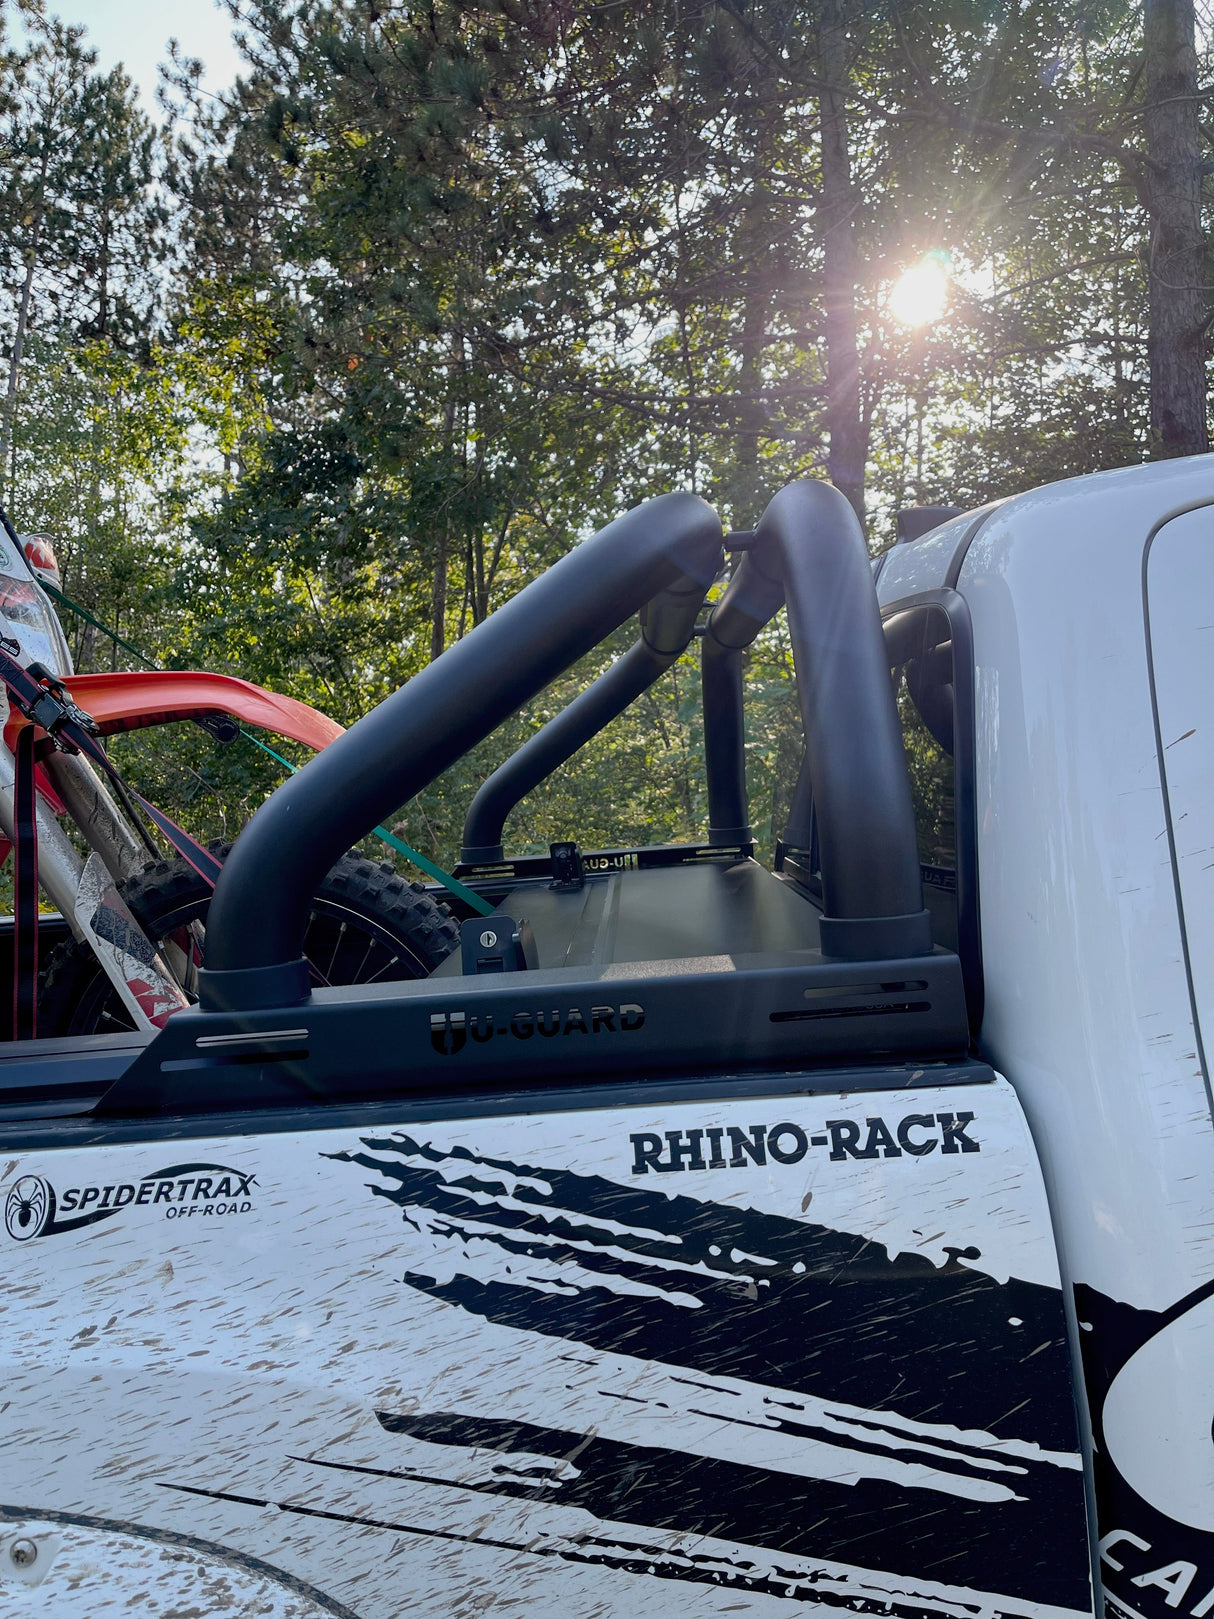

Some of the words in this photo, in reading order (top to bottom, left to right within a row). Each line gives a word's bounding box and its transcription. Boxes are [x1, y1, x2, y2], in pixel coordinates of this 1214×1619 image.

[470, 1003, 646, 1043] U-GUARD
[629, 1111, 980, 1174] RHINO-RACK
[59, 1174, 257, 1212] SPIDERTRAX
[165, 1201, 252, 1220] OFF-ROAD
